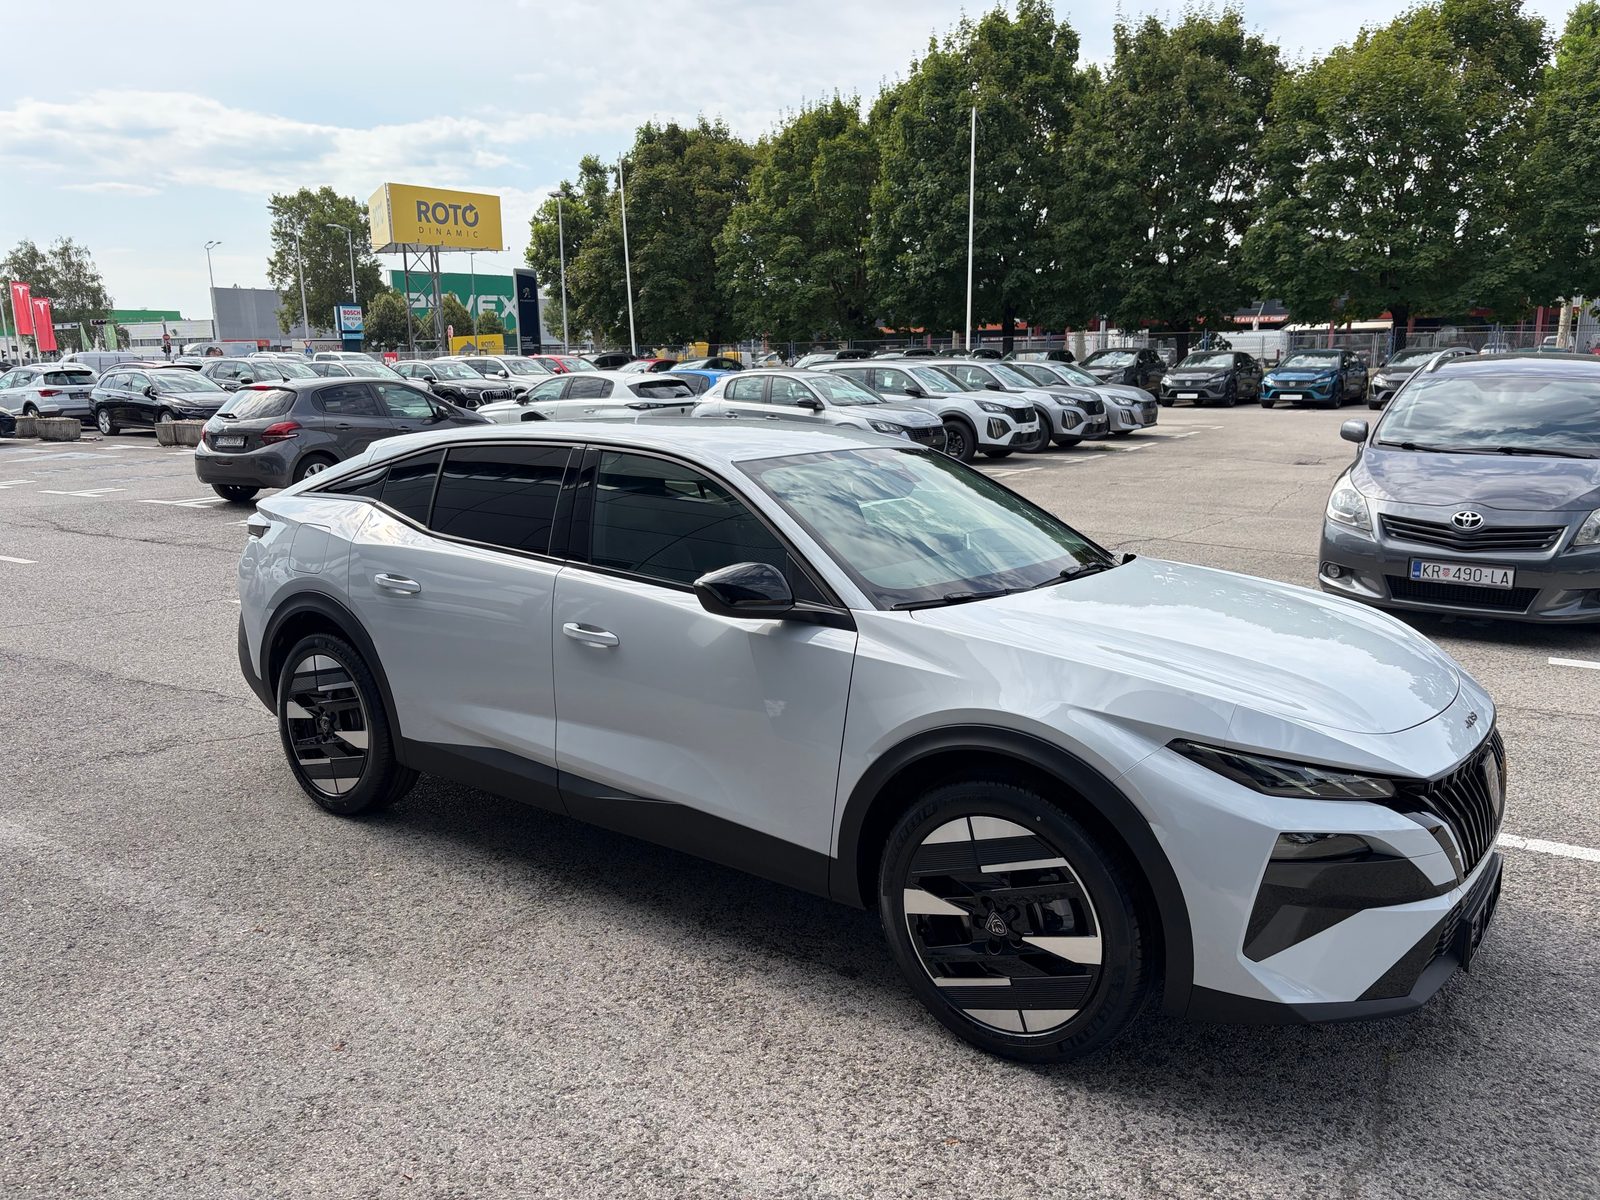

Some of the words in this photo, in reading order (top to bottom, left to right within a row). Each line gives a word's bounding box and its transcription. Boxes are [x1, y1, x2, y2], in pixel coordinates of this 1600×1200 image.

[416, 200, 479, 228] ROTO
[418, 226, 479, 239] DINAMIC
[1422, 563, 1441, 578] KR
[1452, 567, 1509, 585] 490-LA
